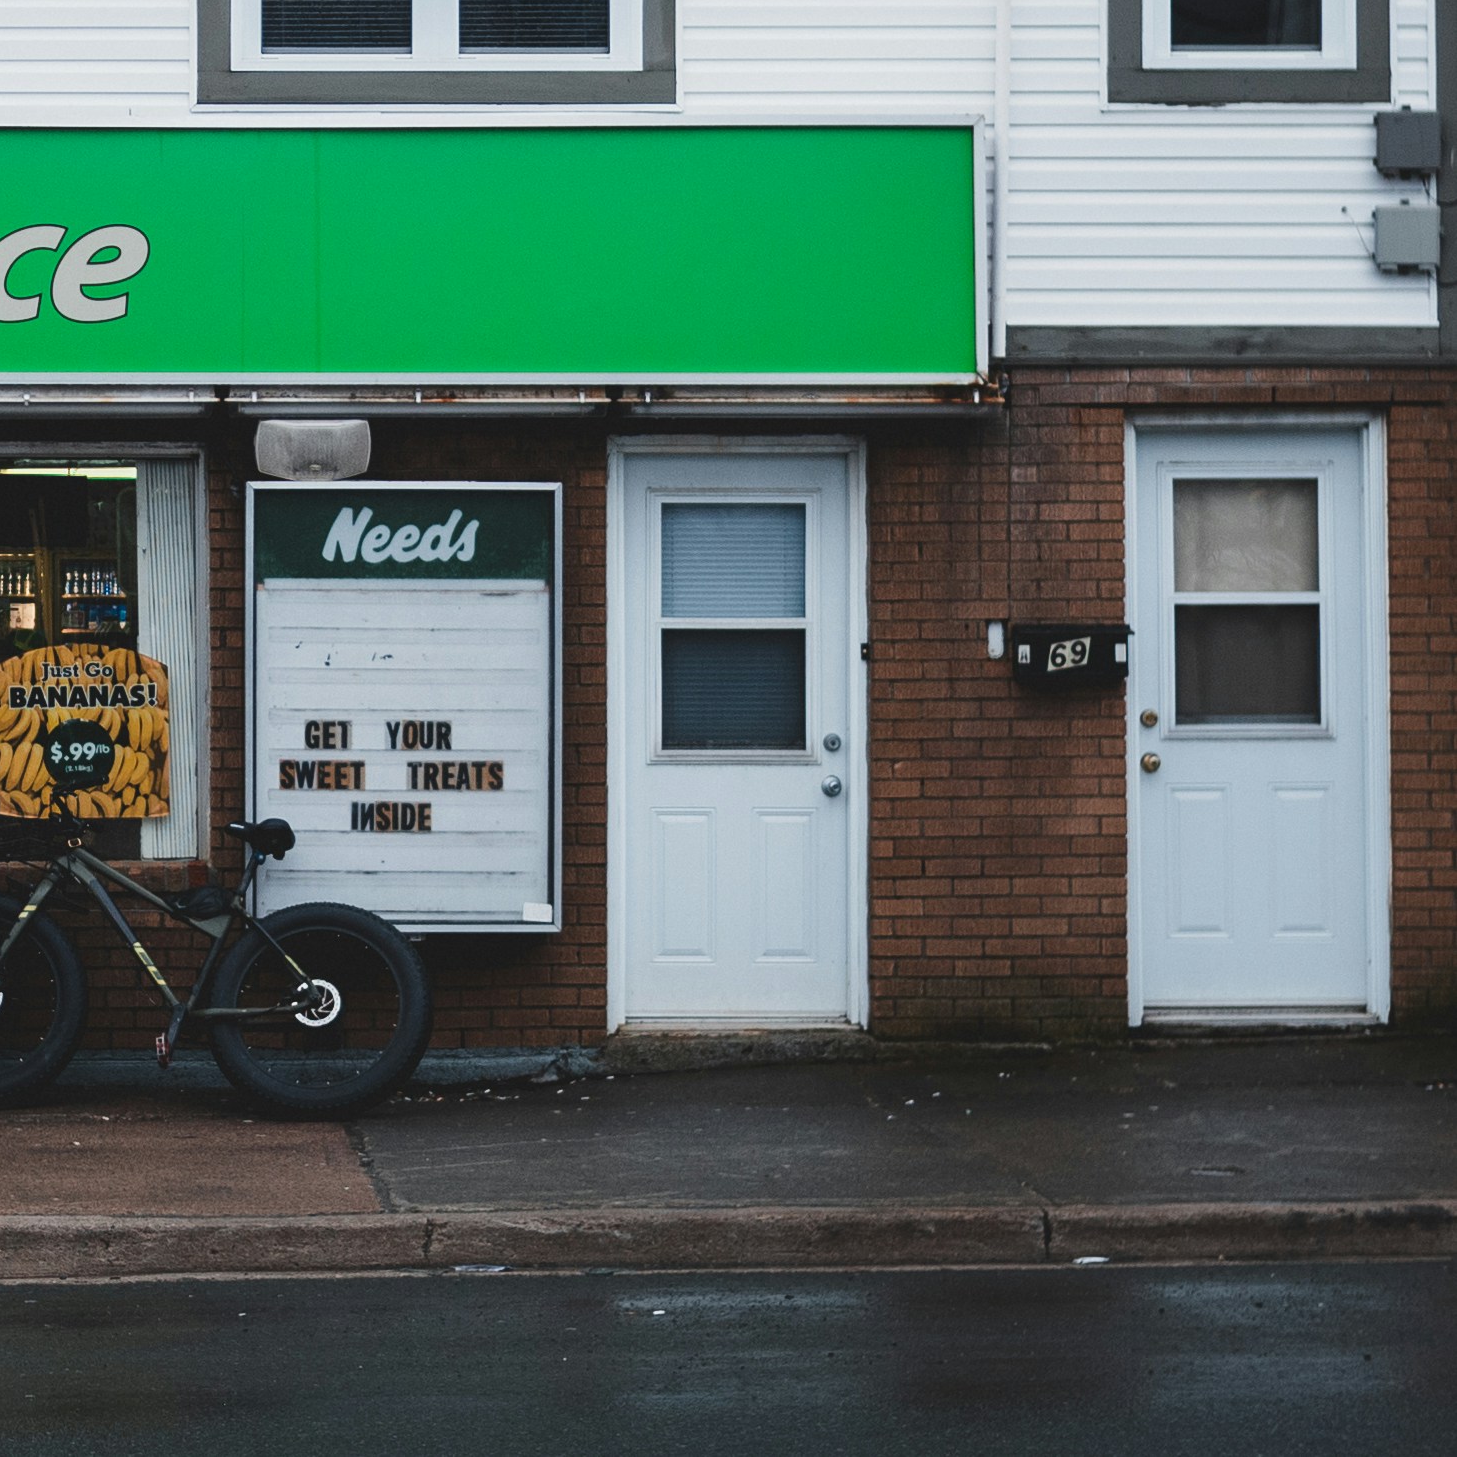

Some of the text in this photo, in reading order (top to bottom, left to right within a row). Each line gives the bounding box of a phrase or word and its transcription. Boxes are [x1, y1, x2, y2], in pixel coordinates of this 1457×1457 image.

[321, 506, 480, 564] Needs
[1050, 640, 1087, 667] 69
[42, 662, 113, 681] Just Go
[9, 682, 157, 709] BANANAS!
[304, 720, 452, 750] GET YOUR
[279, 760, 503, 790] SWEET TREATS
[351, 802, 431, 832] INSIDE
